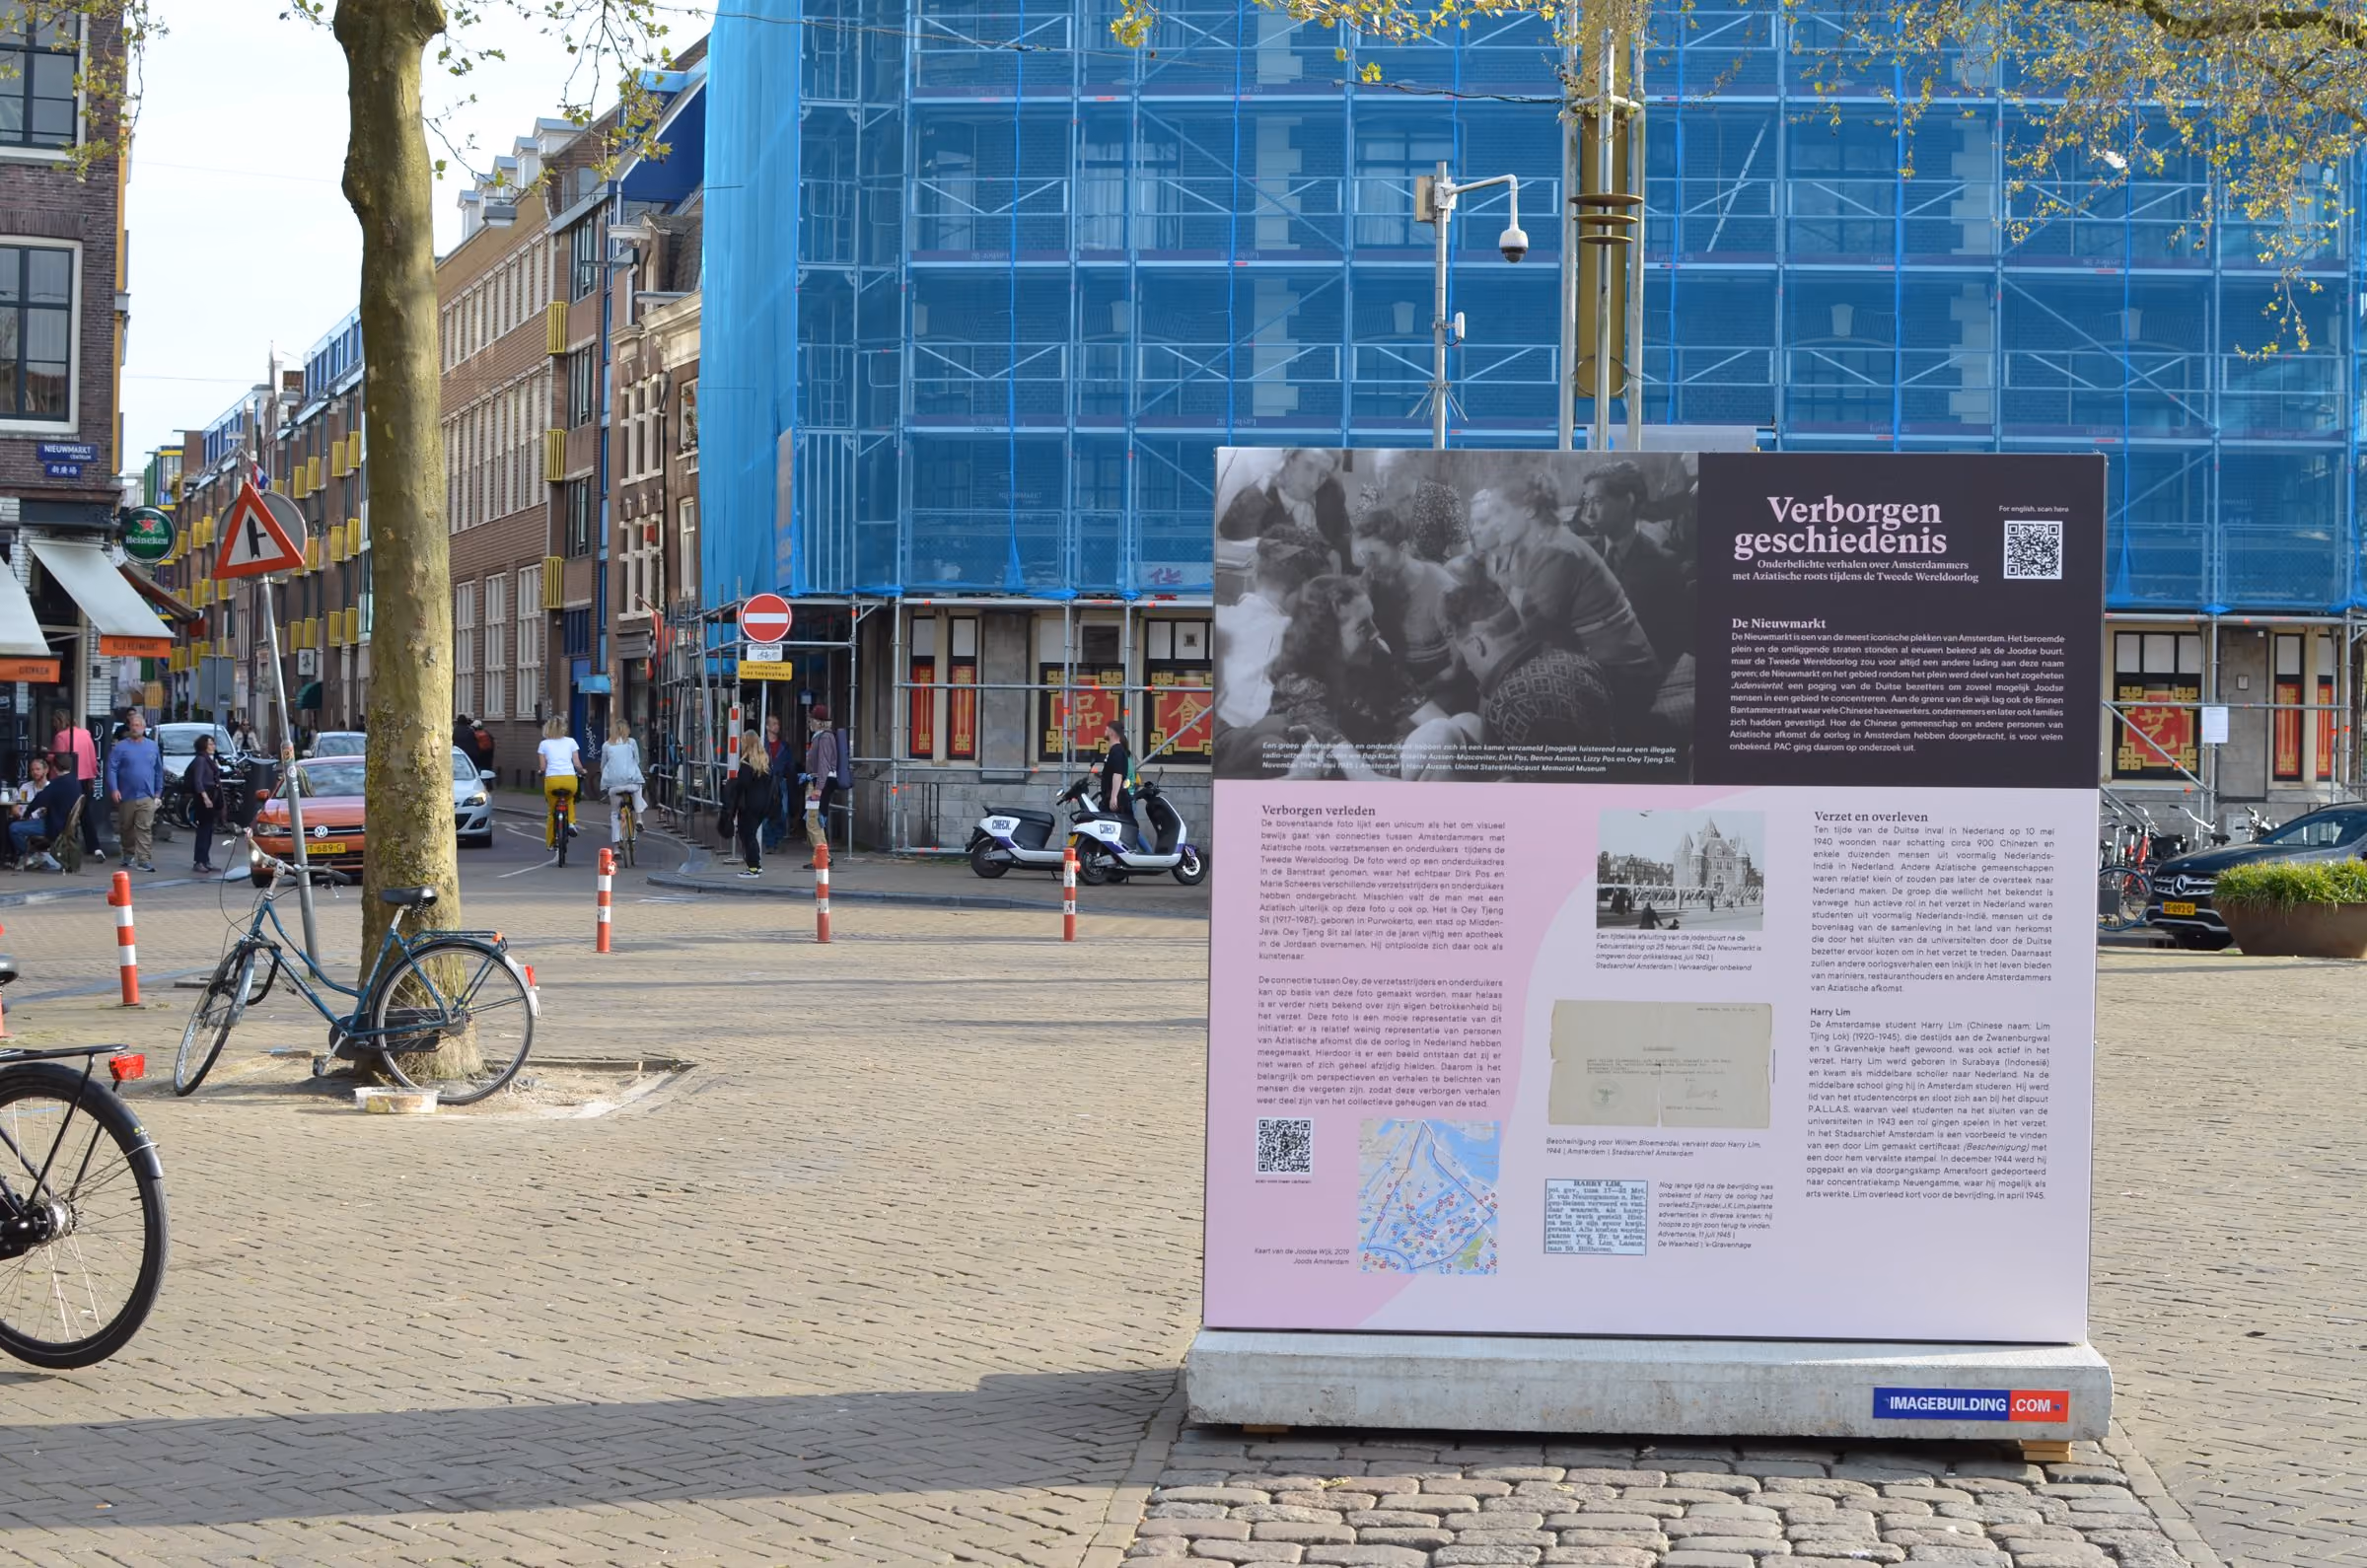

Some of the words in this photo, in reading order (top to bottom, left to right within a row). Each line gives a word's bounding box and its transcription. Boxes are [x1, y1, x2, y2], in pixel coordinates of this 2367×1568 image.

[44, 445, 91, 454] NIEUWMARKT
[1767, 495, 1942, 530] Verborgen
[126, 536, 168, 545] Heineken
[1733, 526, 1948, 561] geschiedenis
[1757, 559, 1824, 568] Onderbelichte
[1826, 559, 1867, 568] verhalen
[1891, 560, 1969, 569] Amsterdammers
[1752, 571, 1801, 580] Aziatische
[1829, 571, 1862, 582] tijdens
[1863, 571, 1875, 580] de
[1876, 571, 1913, 580] Tweede
[1915, 572, 1978, 582] Wereldoorlog
[1732, 618, 1748, 628] De
[1751, 618, 1825, 628] Nieuwmarkt
[1731, 632, 1743, 640] De
[1909, 633, 1942, 642] plekken
[1731, 645, 1752, 653] plein
[1781, 645, 1829, 654] omliggende
[1768, 656, 1800, 665] Tweede
[1802, 657, 1858, 666] Wereldoorlog
[1899, 658, 1920, 667] altijd
[1972, 658, 1998, 668] lading
[1848, 670, 1877, 679] gebied
[1926, 670, 1947, 679] plein
[2021, 672, 2064, 680] zogeheten
[1807, 683, 1836, 691] poging
[1995, 683, 2030, 692] mogelijk
[1067, 694, 1104, 728] 品
[1168, 693, 1205, 734] 食
[2139, 708, 2178, 750] 艺
[1262, 804, 1322, 817] Verborgen
[1325, 805, 1375, 815] verleden
[1814, 811, 1851, 821] Verzet
[1871, 813, 1928, 821] overleven
[1810, 1008, 1833, 1016] Harry
